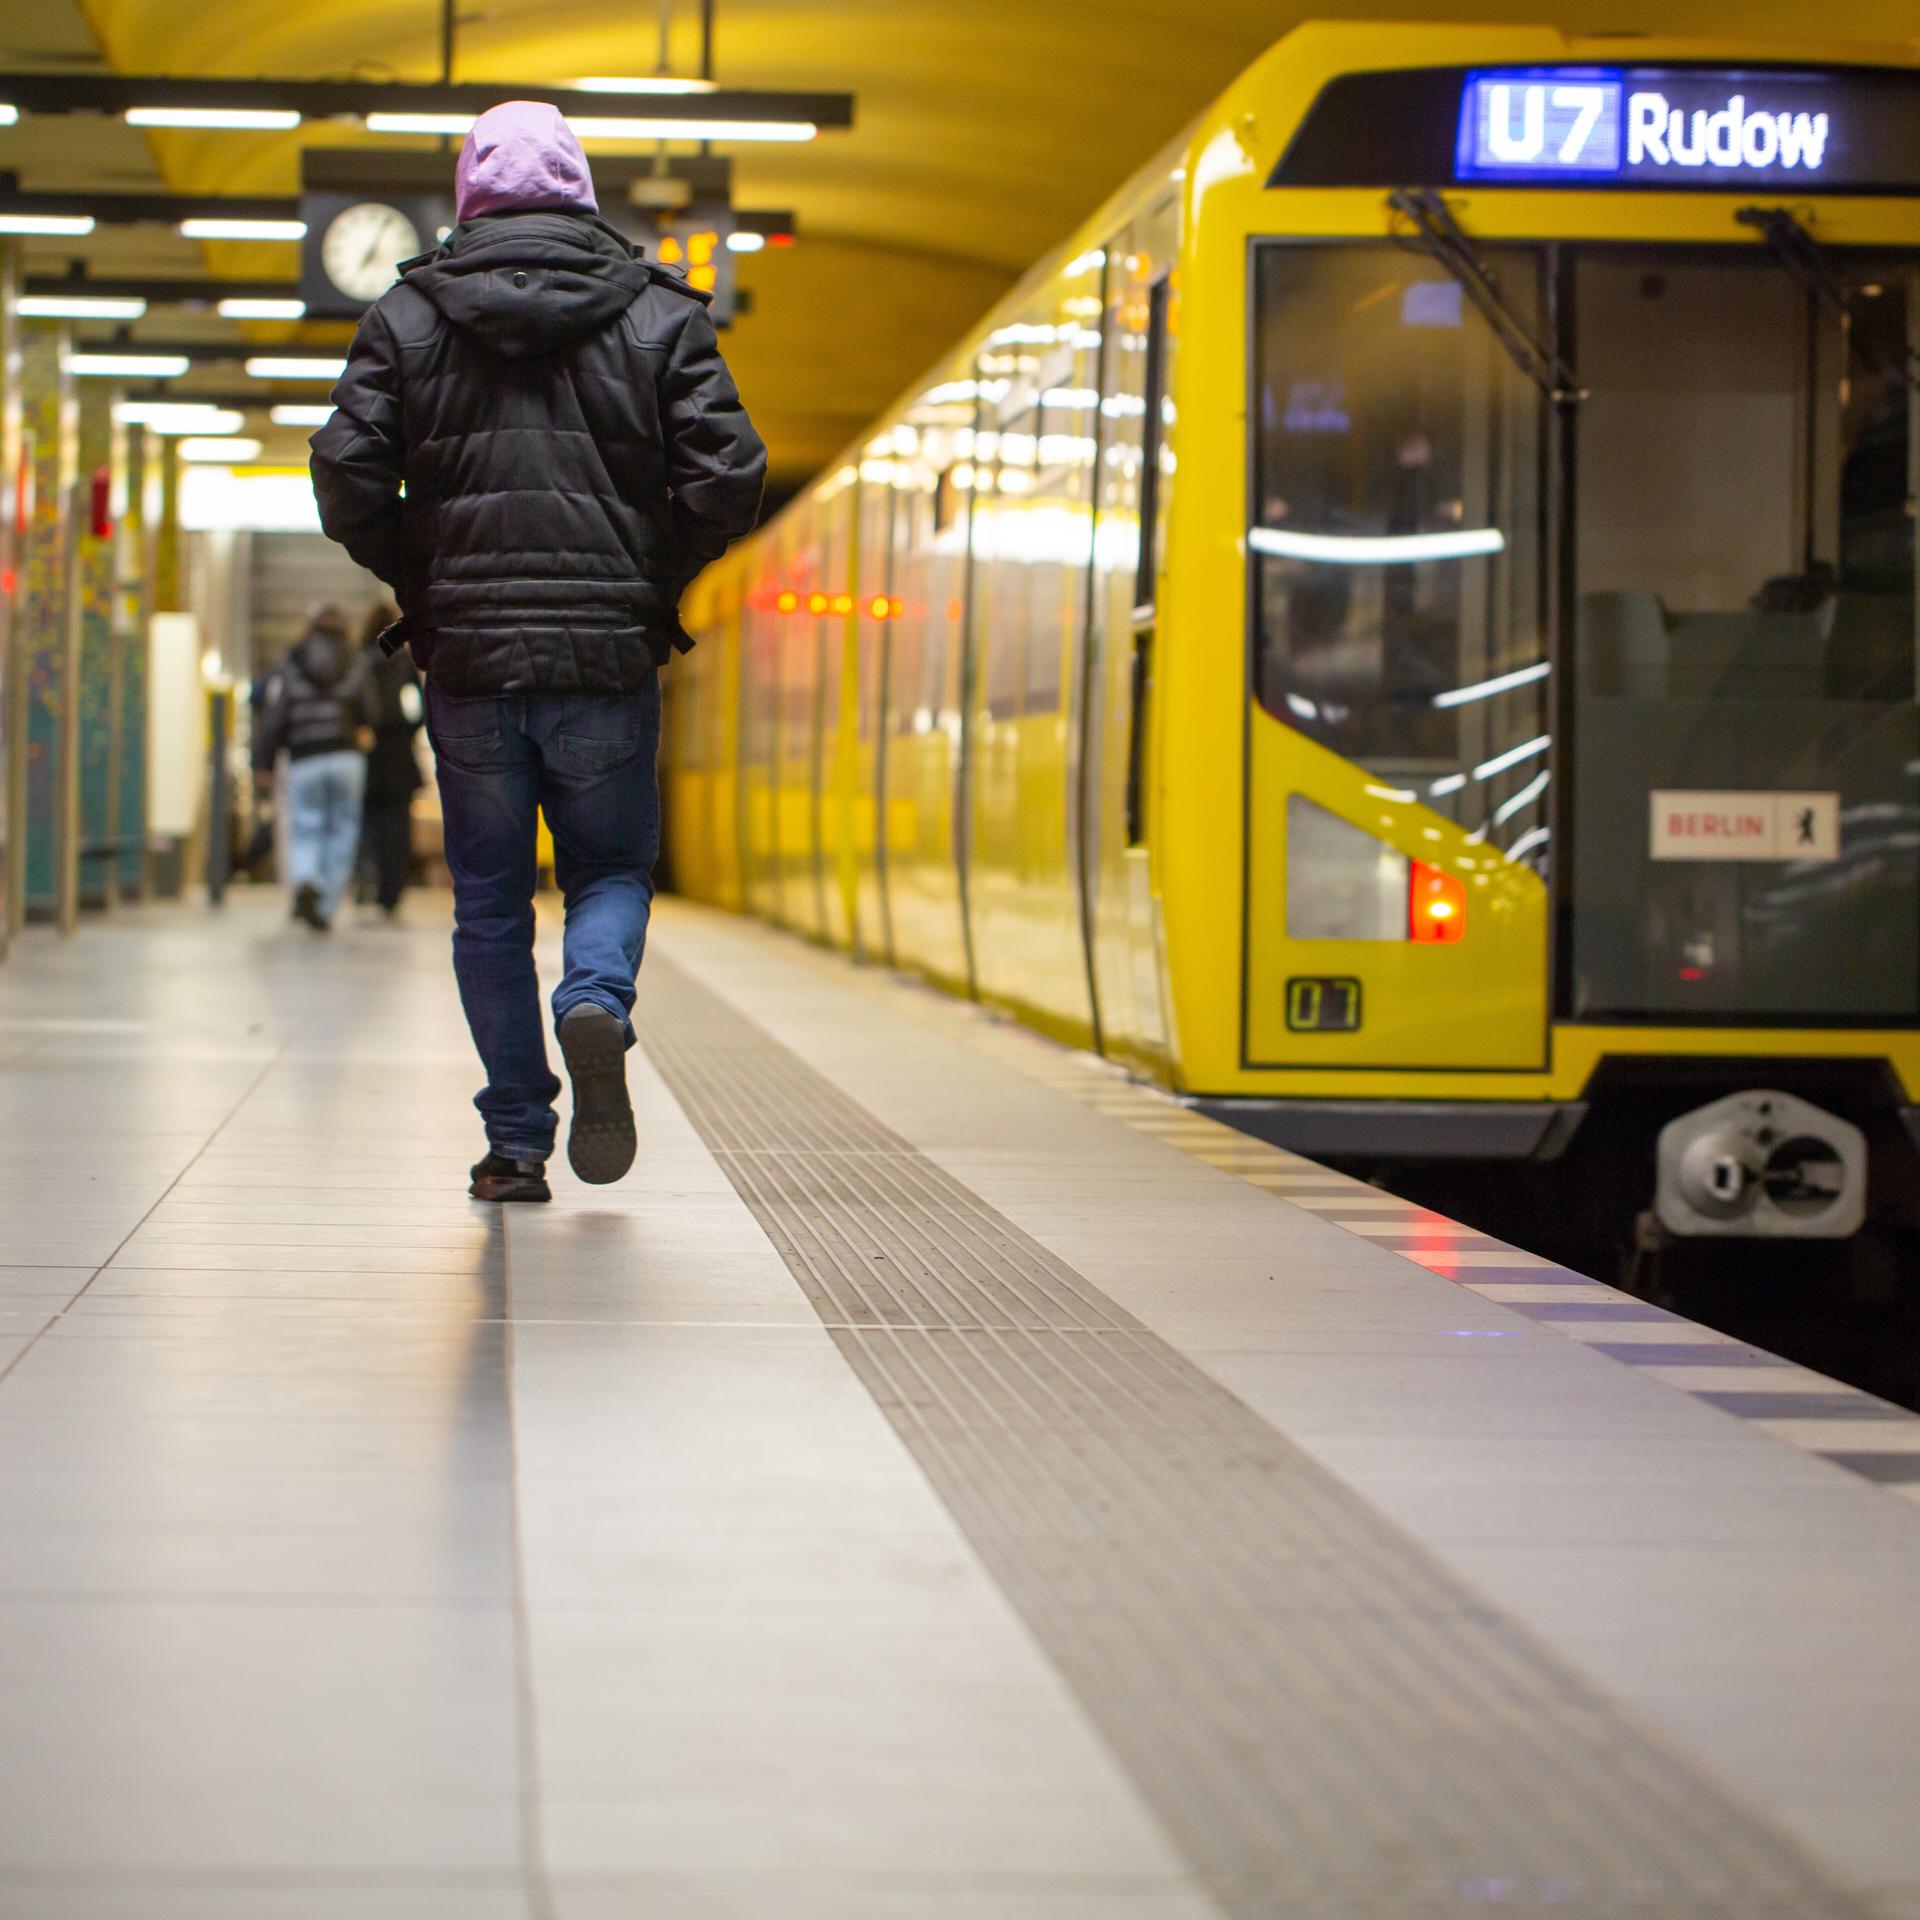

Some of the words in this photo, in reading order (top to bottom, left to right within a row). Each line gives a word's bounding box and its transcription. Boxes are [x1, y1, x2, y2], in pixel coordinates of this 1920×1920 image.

[1488, 84, 1604, 163] U7
[1626, 92, 1829, 169] Rudow
[1667, 813, 1764, 838] BERLIN
